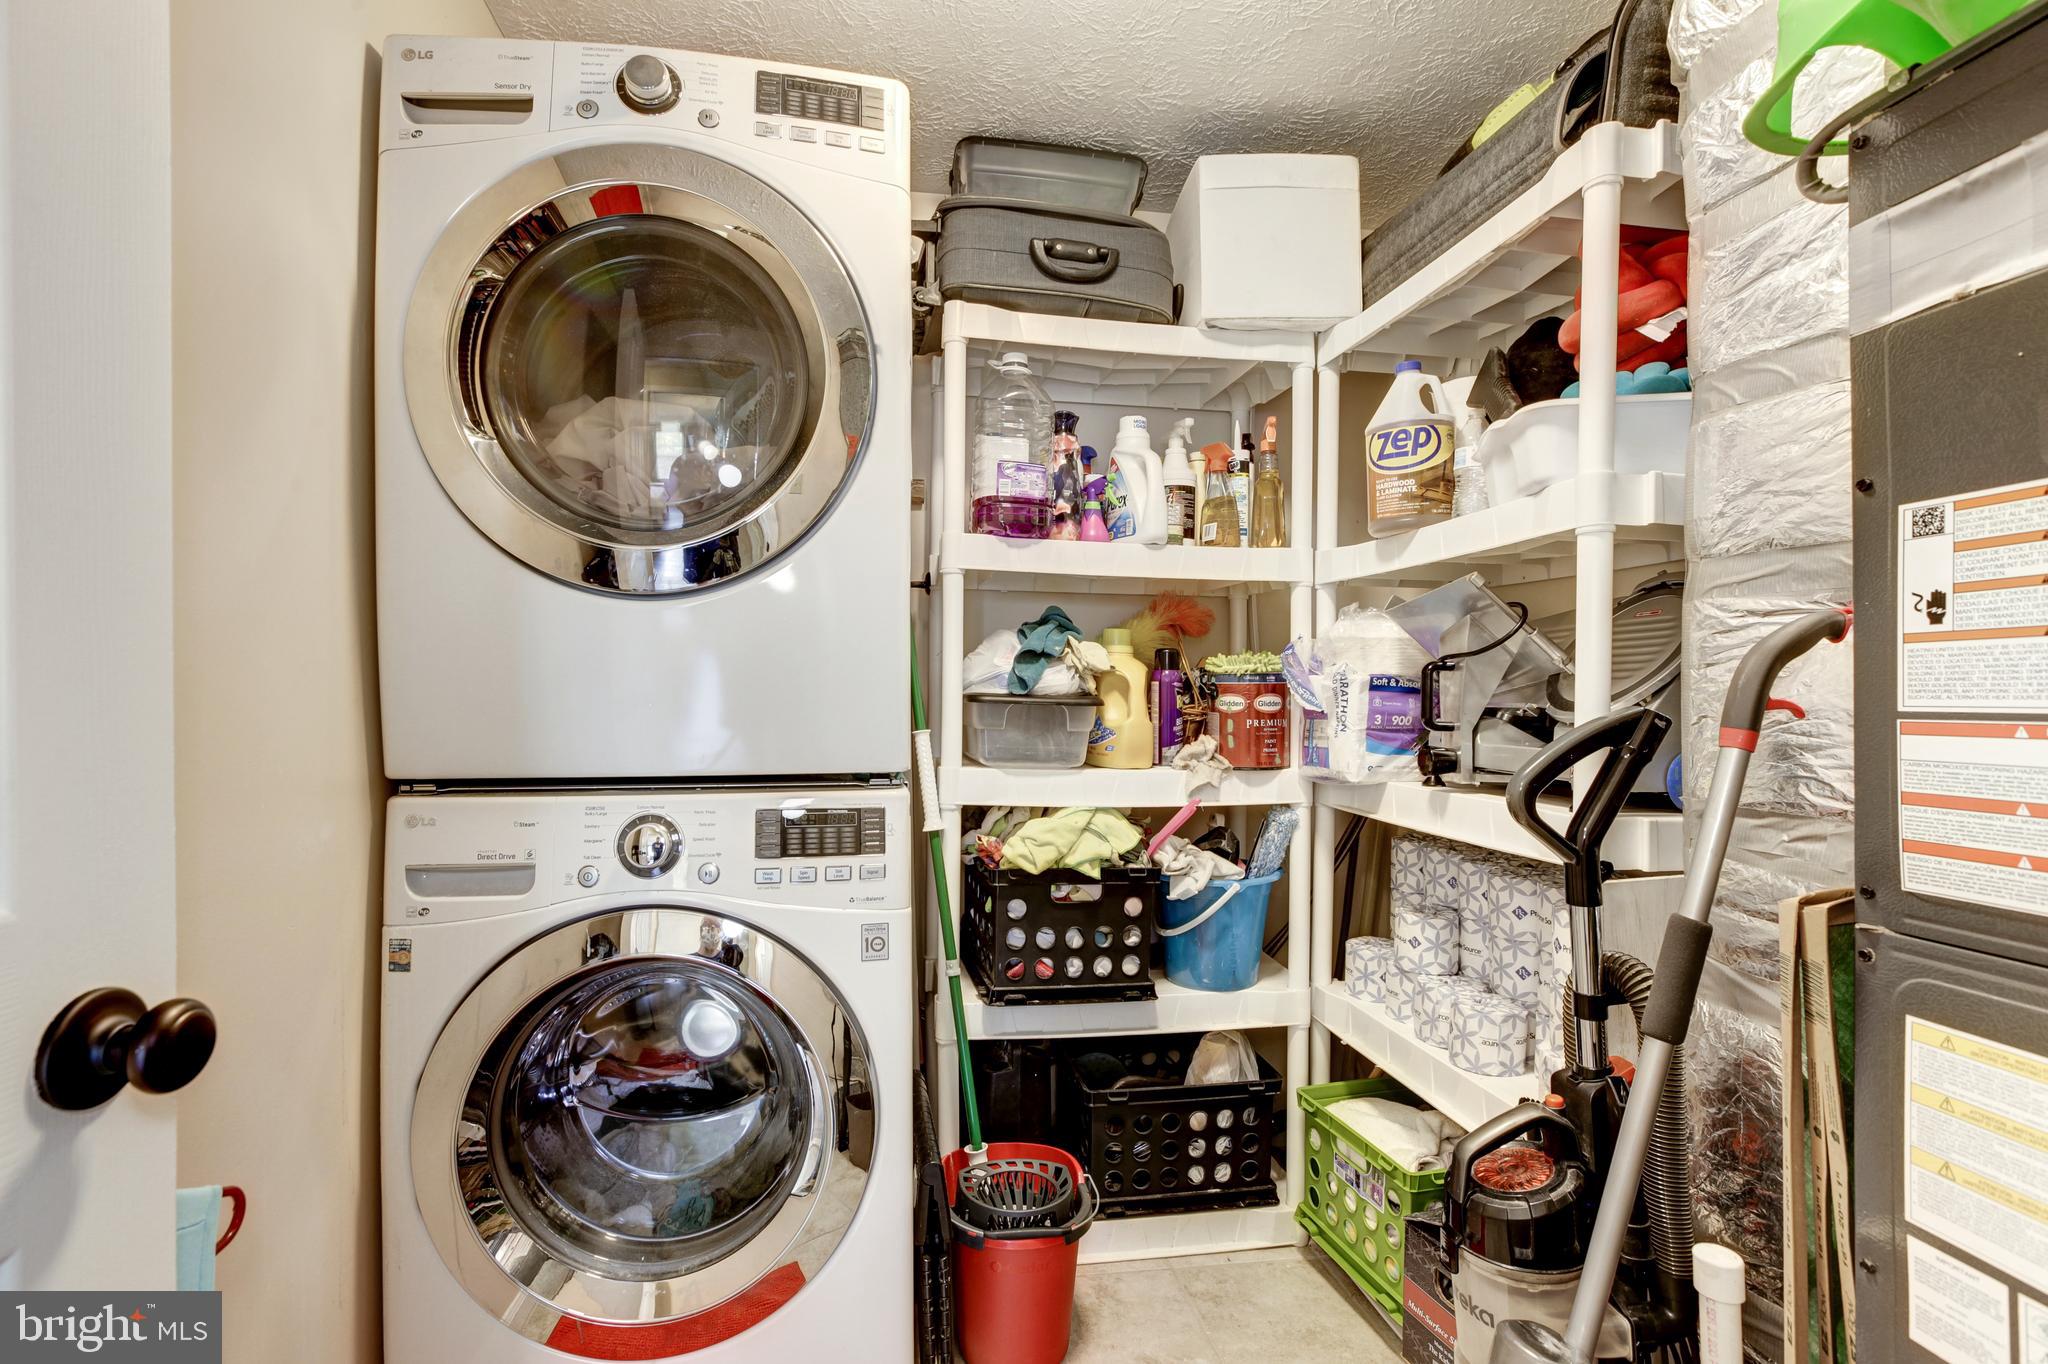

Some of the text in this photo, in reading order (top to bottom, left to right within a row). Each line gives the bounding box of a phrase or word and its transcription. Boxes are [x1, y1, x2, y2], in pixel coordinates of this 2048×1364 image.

[418, 50, 434, 60] LG
[519, 83, 531, 91] Dry
[1376, 479, 1416, 491] HARDWOOD
[1381, 485, 1418, 496] LAMINATE
[1988, 526, 2012, 535] WHEN
[1956, 551, 1987, 560] DANGER
[2003, 546, 2026, 554] CHOC
[1966, 556, 2005, 566] COURANT
[2007, 552, 2033, 561] AVANT
[1956, 558, 2040, 574] COMPARTIMENT DOIT
[2004, 588, 2038, 597] CHOQUE
[1956, 600, 1982, 608] TODAS
[2000, 595, 2038, 604] FUENTES
[1955, 604, 2020, 615] MANTENIMIENTO
[1977, 611, 2033, 620] PERMANECER
[1372, 678, 1388, 686] Soft
[1390, 678, 1397, 686] &
[1219, 699, 1243, 707] Glidden
[1257, 699, 1281, 707] Glidden
[1246, 719, 1288, 729] PREMIUM
[1374, 714, 1413, 726] 3 900
[1904, 807, 1929, 815] RISQUE
[420, 818, 437, 827] LG
[1906, 855, 1932, 864] RIESGO
[1998, 868, 2015, 876] POR
[864, 936, 886, 952] 10
[1408, 1299, 1448, 1339] Multi-Surface
[1821, 1325, 1829, 1356] EZ
[1427, 1342, 1438, 1357] The
